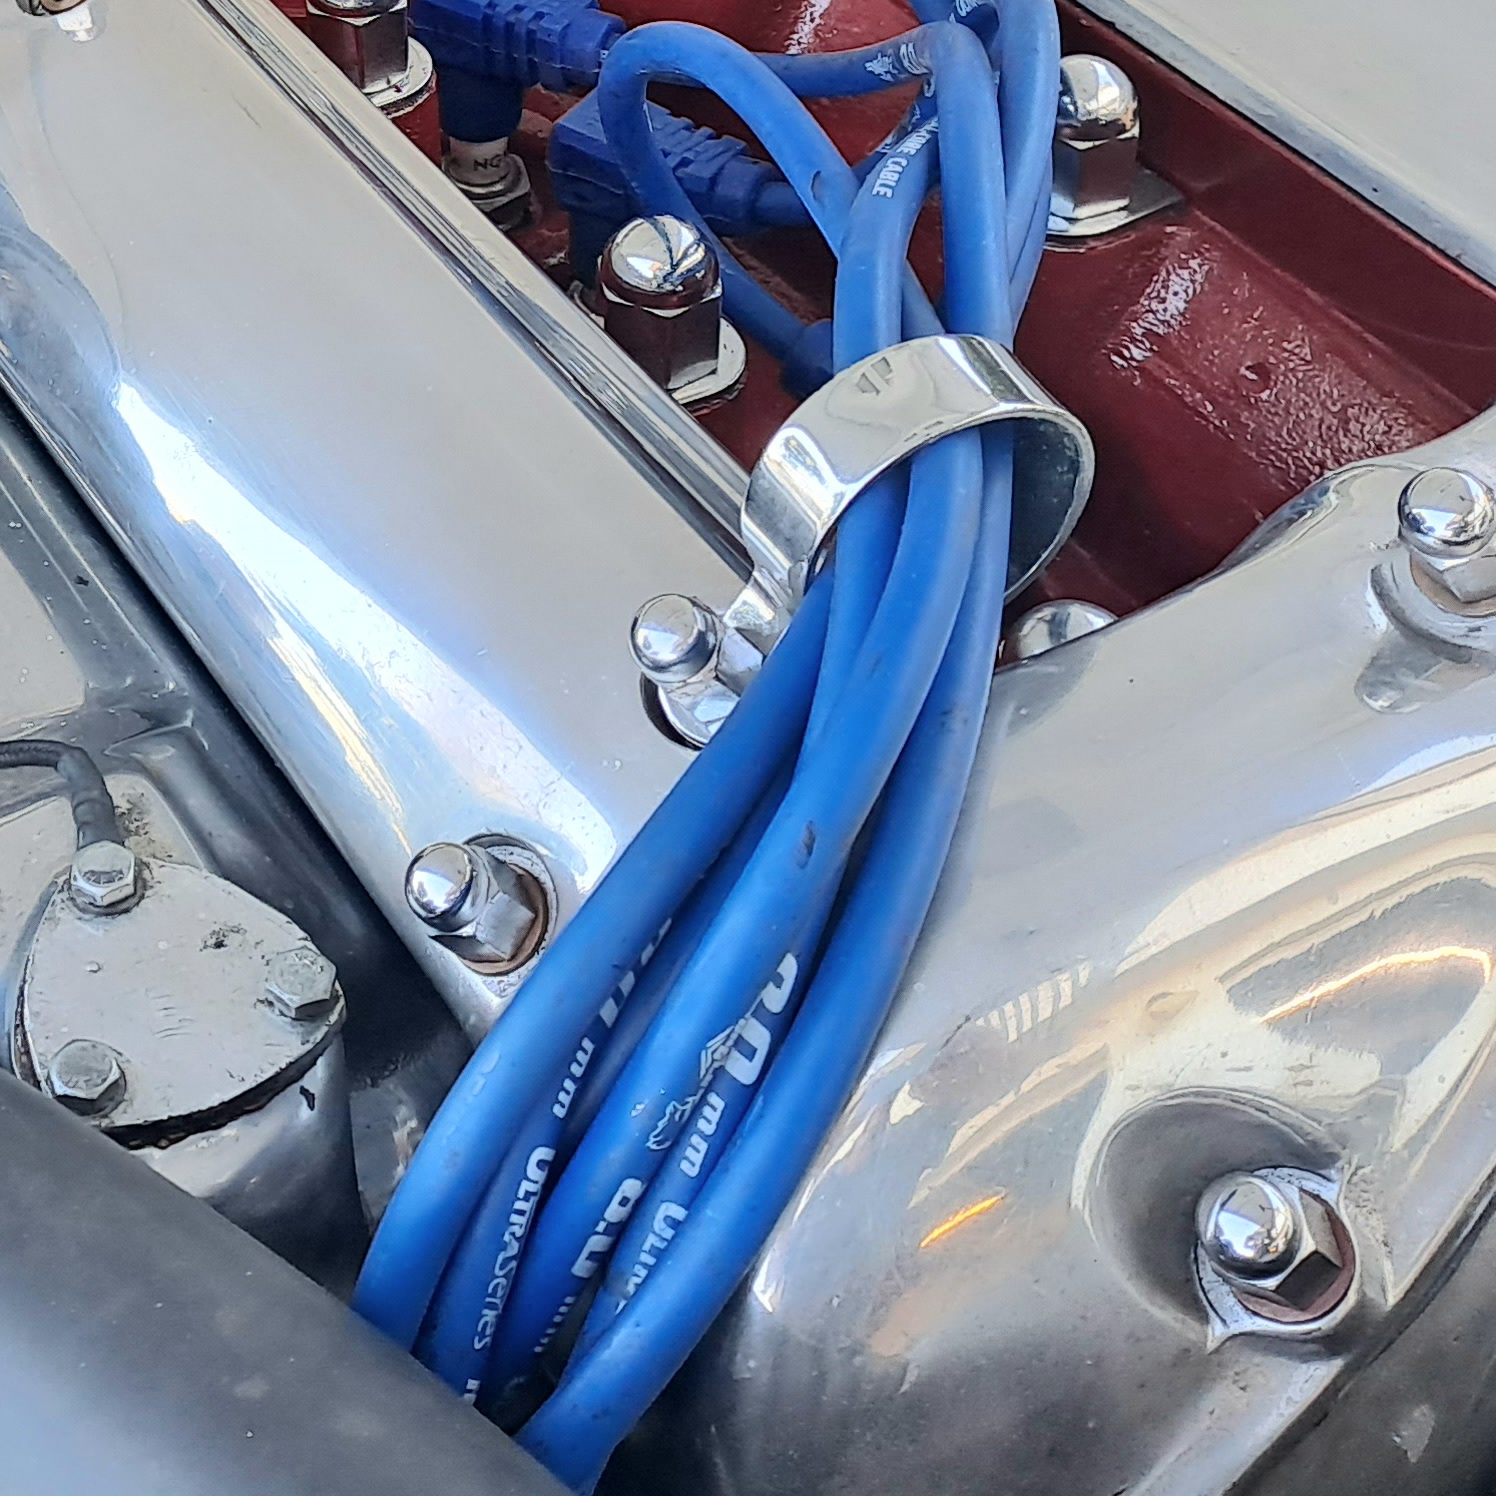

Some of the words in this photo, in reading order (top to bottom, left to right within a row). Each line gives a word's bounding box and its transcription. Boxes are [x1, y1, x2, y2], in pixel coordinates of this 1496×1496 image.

[870, 158, 908, 198] CABLE
[553, 1035, 597, 1120] mm
[679, 1091, 727, 1179] mm
